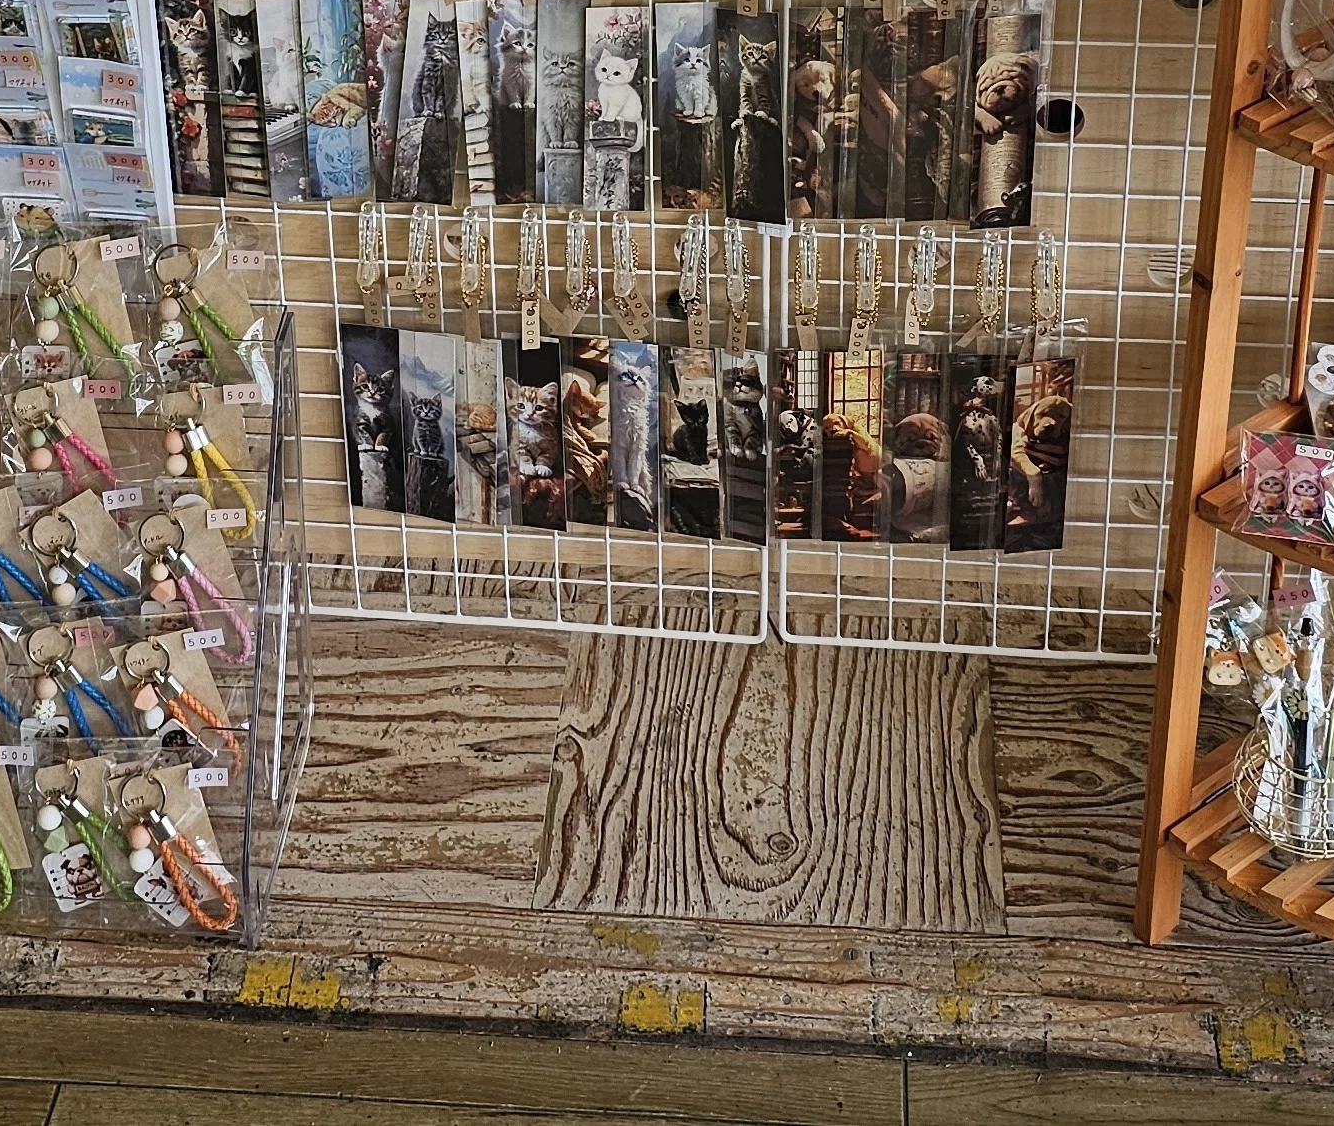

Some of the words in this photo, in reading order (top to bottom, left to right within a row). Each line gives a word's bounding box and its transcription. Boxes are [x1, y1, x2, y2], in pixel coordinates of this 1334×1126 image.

[1, 55, 30, 64] 300
[108, 74, 135, 87] 300
[27, 157, 56, 168] 300
[111, 155, 138, 166] 300
[105, 243, 134, 255] 500
[232, 255, 259, 265] 500
[527, 320, 535, 344] 300
[852, 332, 863, 358] 300
[88, 385, 116, 394] 500
[227, 390, 256, 400] 500
[1299, 445, 1333, 458] 500
[107, 493, 136, 505] 500
[210, 512, 240, 522] 500
[1278, 589, 1309, 604] 450
[80, 630, 109, 641] 500
[188, 636, 217, 647] 500
[1, 748, 28, 761] 500
[194, 772, 224, 783] 500
